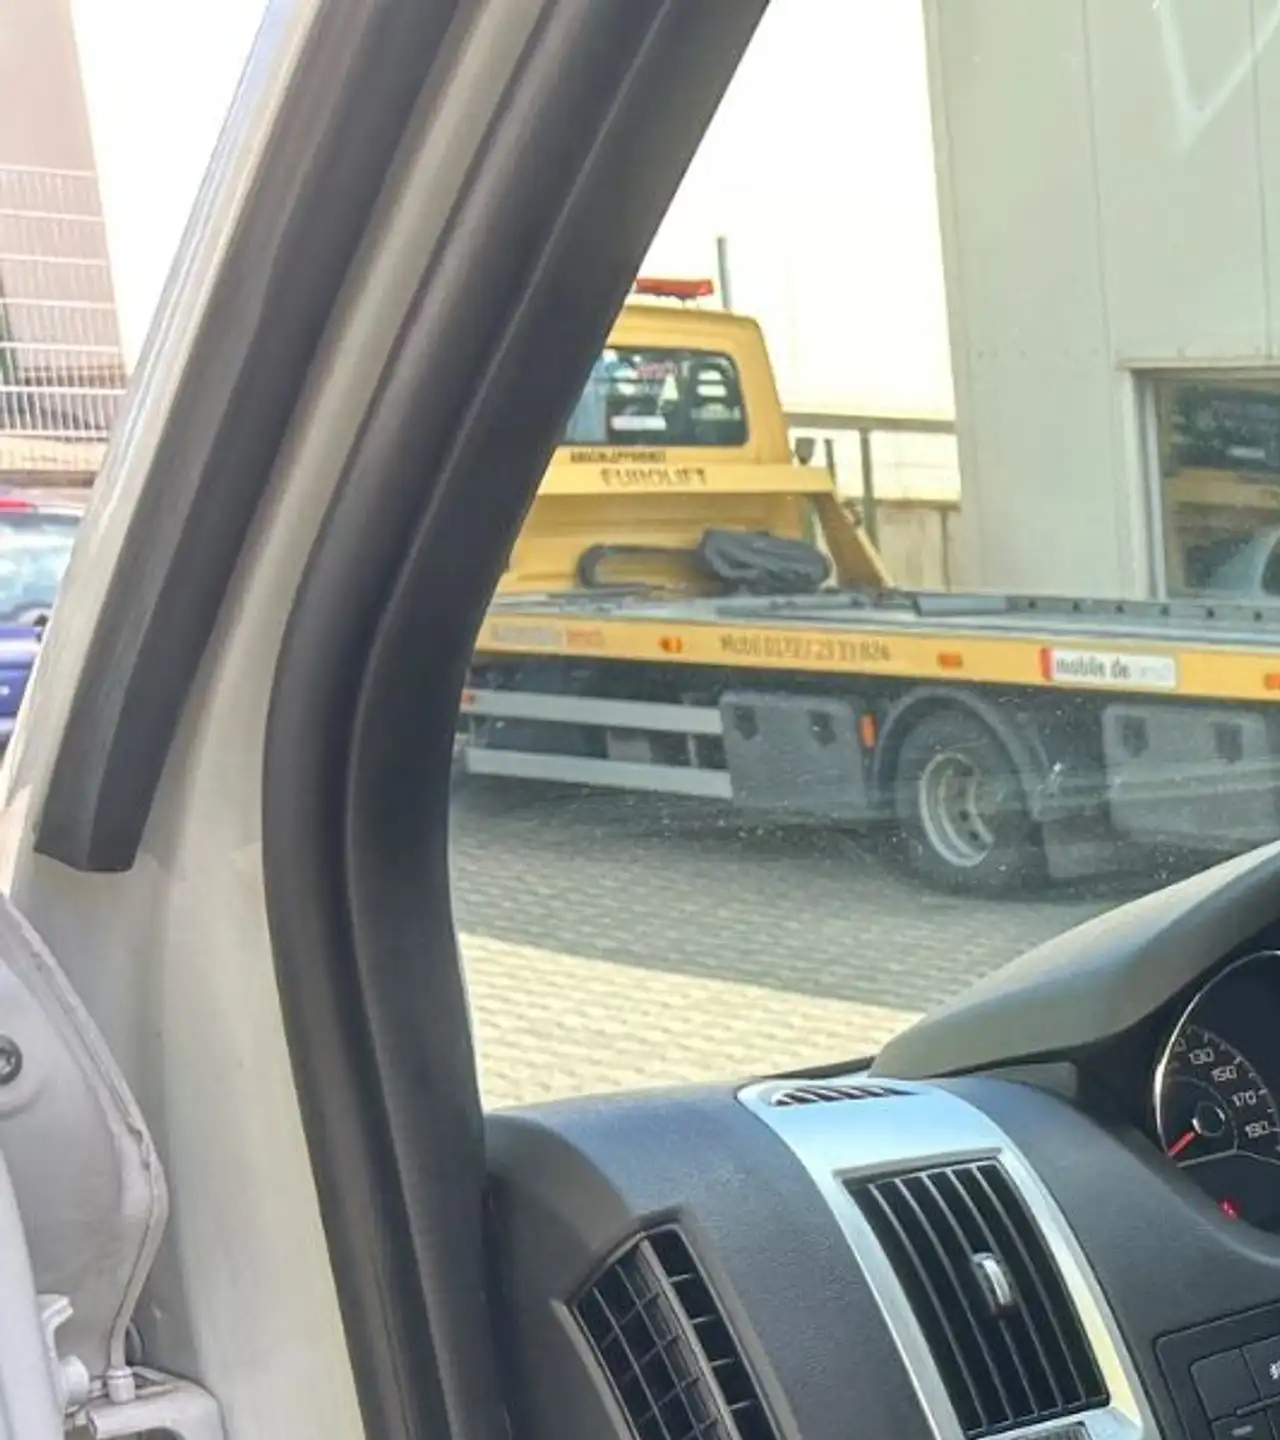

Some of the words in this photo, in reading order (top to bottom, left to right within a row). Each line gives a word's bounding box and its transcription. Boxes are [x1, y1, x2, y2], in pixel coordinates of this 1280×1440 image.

[1188, 1047, 1215, 1065] 130
[1210, 1064, 1237, 1082] 150
[1231, 1089, 1257, 1107] 170
[1244, 1120, 1270, 1139] 190
